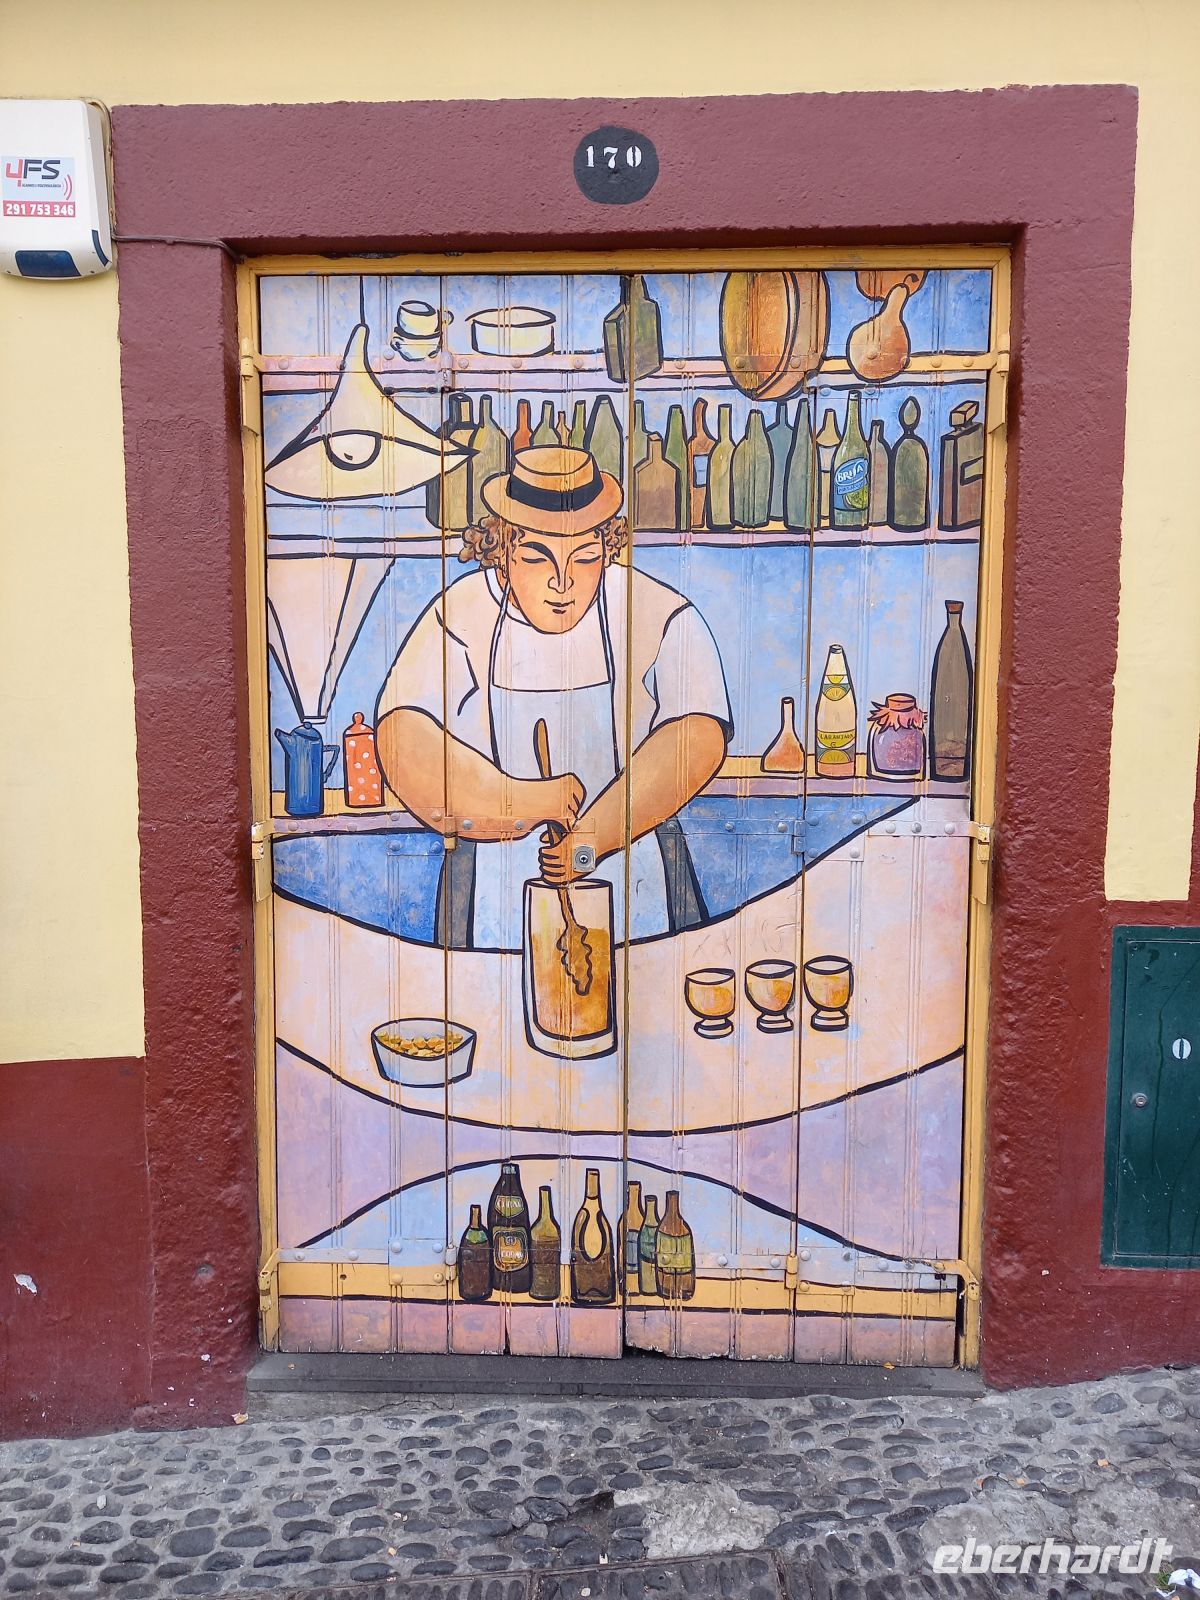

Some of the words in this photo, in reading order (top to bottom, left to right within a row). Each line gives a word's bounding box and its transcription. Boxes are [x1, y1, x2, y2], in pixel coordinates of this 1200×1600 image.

[585, 145, 642, 169] 170
[6, 203, 26, 215] 291
[30, 204, 51, 216] 753
[53, 204, 74, 217] 346
